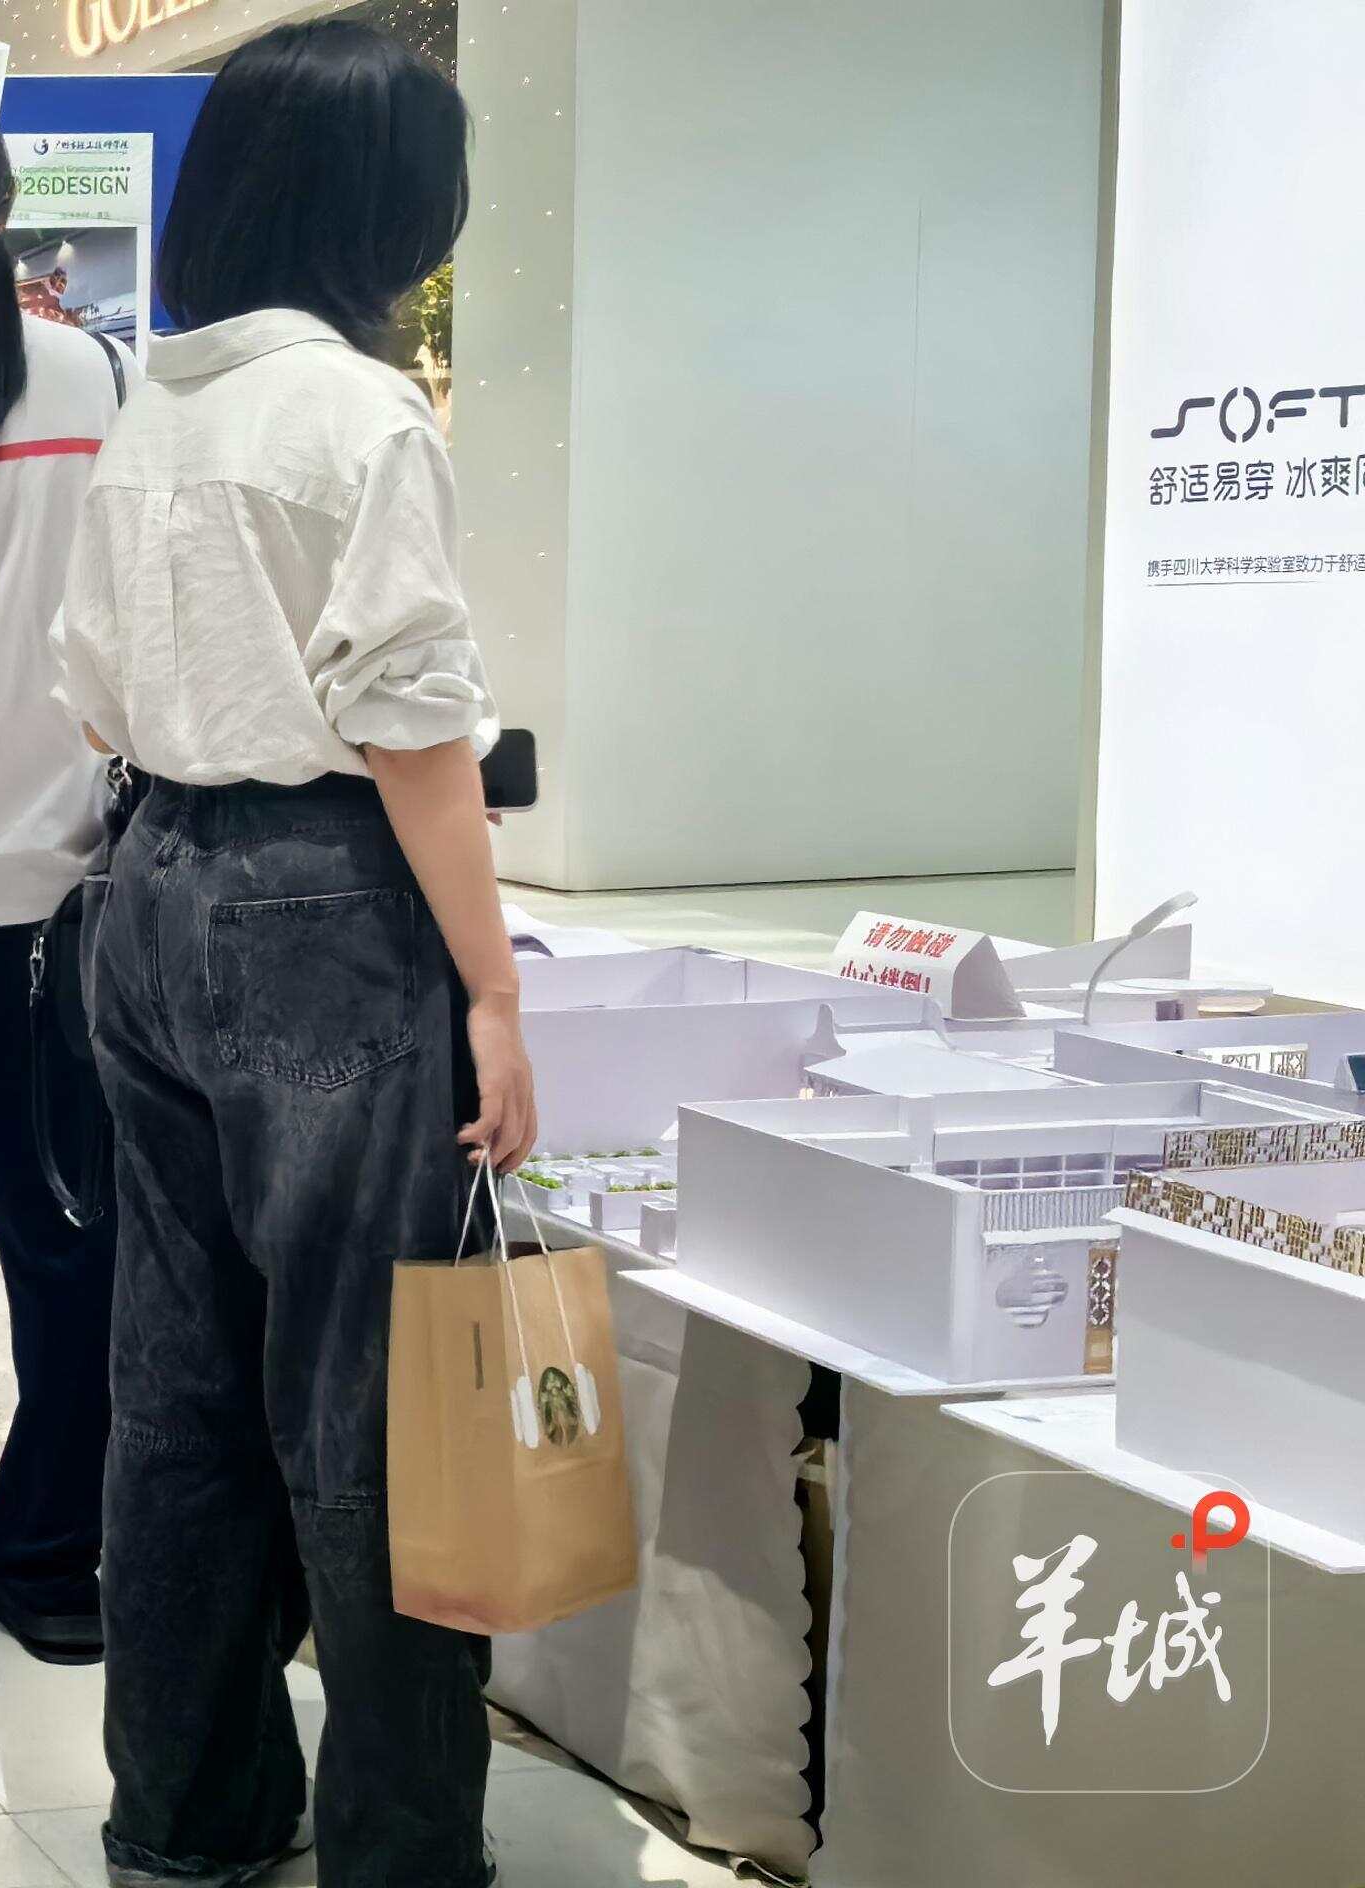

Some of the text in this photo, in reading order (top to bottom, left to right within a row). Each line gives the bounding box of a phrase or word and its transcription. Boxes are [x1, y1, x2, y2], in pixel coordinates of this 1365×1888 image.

[1149, 459, 1274, 505] 舒适易穿
[863, 921, 958, 958] 请勿触碰
